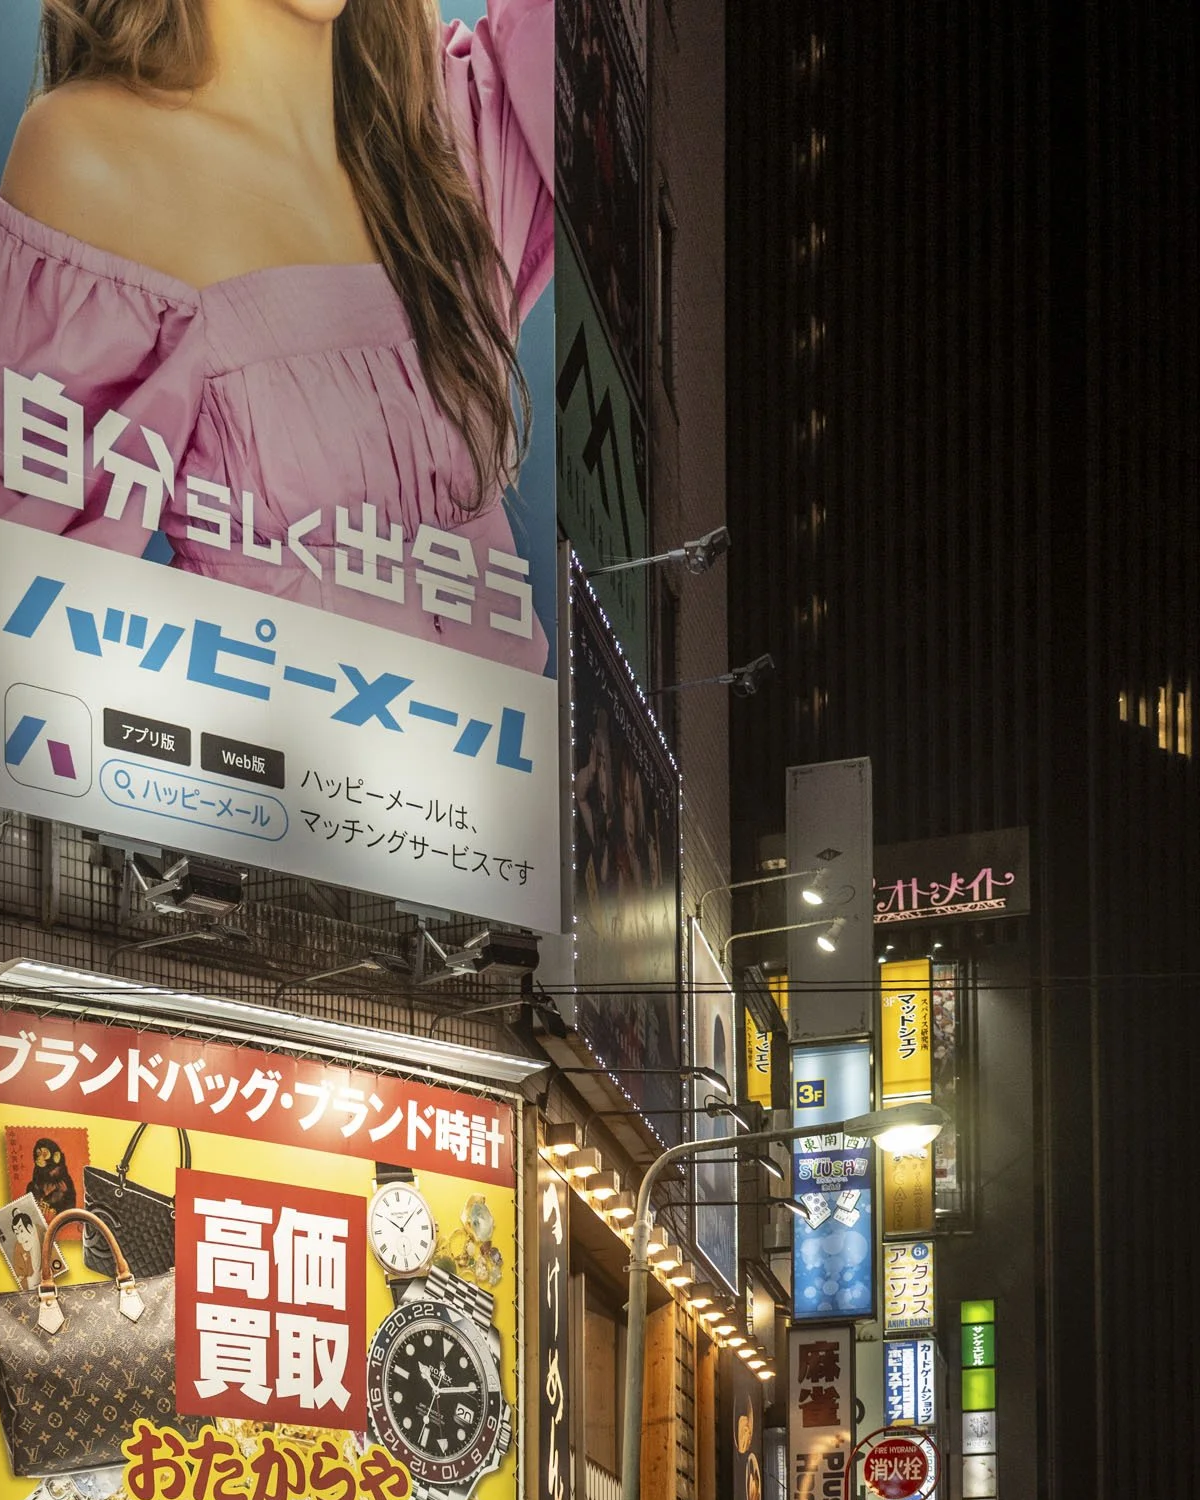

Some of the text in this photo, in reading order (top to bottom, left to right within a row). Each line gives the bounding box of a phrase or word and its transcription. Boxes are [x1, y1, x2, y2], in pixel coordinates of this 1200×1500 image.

[3, 366, 533, 640] 自分らしく出会う
[3, 575, 534, 774] ハッピーメール
[121, 724, 176, 753] アプリ版
[222, 749, 266, 775] Web版
[142, 778, 271, 827] ハッピーメール
[300, 769, 478, 834] ハッピーメールは、
[300, 809, 535, 886] マッチングサービスです
[798, 1084, 823, 1104] 3F
[799, 1160, 856, 1180] SLUSH
[193, 1197, 349, 1313] 高価
[889, 1247, 907, 1316] アニソン
[911, 1261, 929, 1315] ダンス
[888, 1319, 909, 1329] ANIME
[193, 1303, 351, 1413] 買取
[798, 1341, 841, 1428] 麻雀
[920, 1343, 933, 1423] カードゲームショップ
[869, 1457, 923, 1481] 消火栓
[874, 1445, 918, 1455] FIRE HYDRANT
